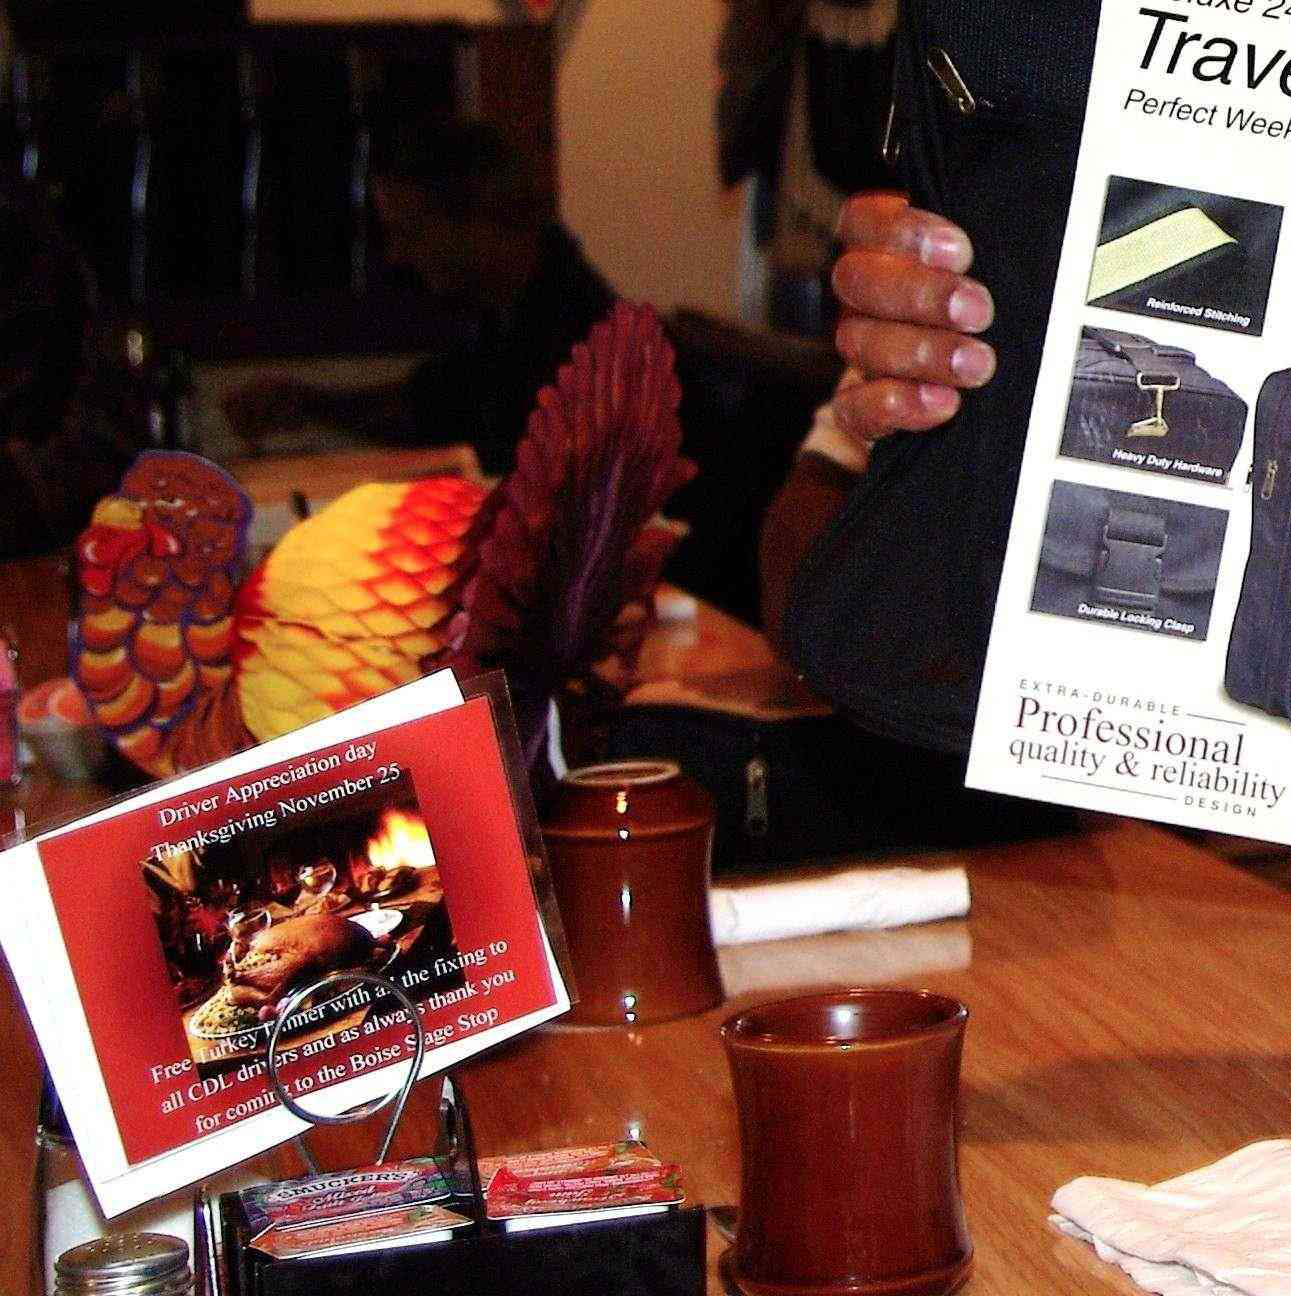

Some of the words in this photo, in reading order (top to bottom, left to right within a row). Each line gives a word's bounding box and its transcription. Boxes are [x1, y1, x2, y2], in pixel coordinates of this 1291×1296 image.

[1123, 89, 1218, 127] Perfect
[1145, 297, 1203, 318] Reinforced
[1203, 306, 1251, 327] Stitching
[1112, 447, 1146, 466] Heavy
[1146, 454, 1173, 471] Duty
[1173, 458, 1223, 478] Hardware
[1077, 603, 1120, 621] Durable
[1119, 610, 1162, 630] Locking
[1163, 617, 1195, 635] Clasp
[1013, 695, 1245, 767] Professional
[1020, 678, 1182, 717] EXTRA-DURABLE
[158, 793, 221, 828] Driver
[225, 755, 341, 806] Appreciation
[344, 741, 377, 764] day
[1009, 737, 1106, 777] quality
[1115, 751, 1140, 778] &
[1150, 760, 1287, 809] reliability
[1184, 795, 1258, 818] DESIGN
[150, 808, 277, 863] Thanksgiving
[278, 774, 375, 818] November
[376, 762, 401, 785] 25
[150, 1057, 193, 1085] Free
[264, 1005, 326, 1037] nner
[331, 987, 372, 1013] with
[400, 968, 431, 989] the
[433, 947, 488, 977] fixing
[489, 940, 509, 957] to
[160, 1089, 185, 1115] all
[188, 1073, 235, 1103] CDL
[302, 1031, 336, 1058] and
[340, 1026, 361, 1044] as
[427, 981, 479, 1011] thank
[480, 968, 517, 996] you
[194, 1112, 222, 1134] for
[295, 1075, 315, 1093] to
[316, 1062, 347, 1083] the
[349, 1042, 402, 1073] Boise
[404, 1023, 456, 1052] Sage
[457, 1007, 500, 1032] Stop
